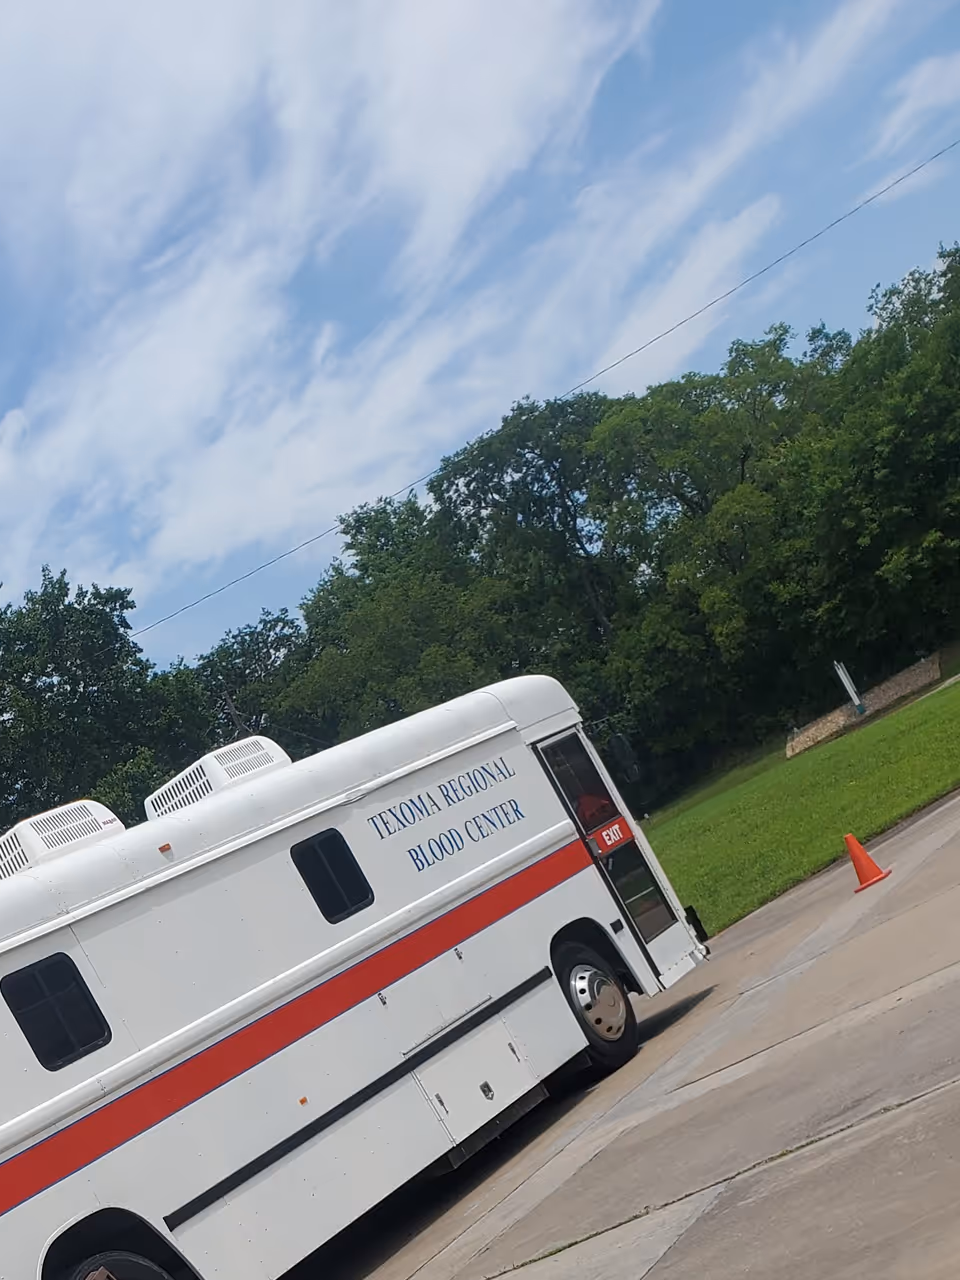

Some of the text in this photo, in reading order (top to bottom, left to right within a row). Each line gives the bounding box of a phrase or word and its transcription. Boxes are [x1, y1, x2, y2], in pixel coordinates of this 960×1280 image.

[367, 756, 516, 840] TEXOMA REGIONAL
[406, 798, 526, 872] BLOOD CENTER
[602, 823, 623, 846] EXIT
